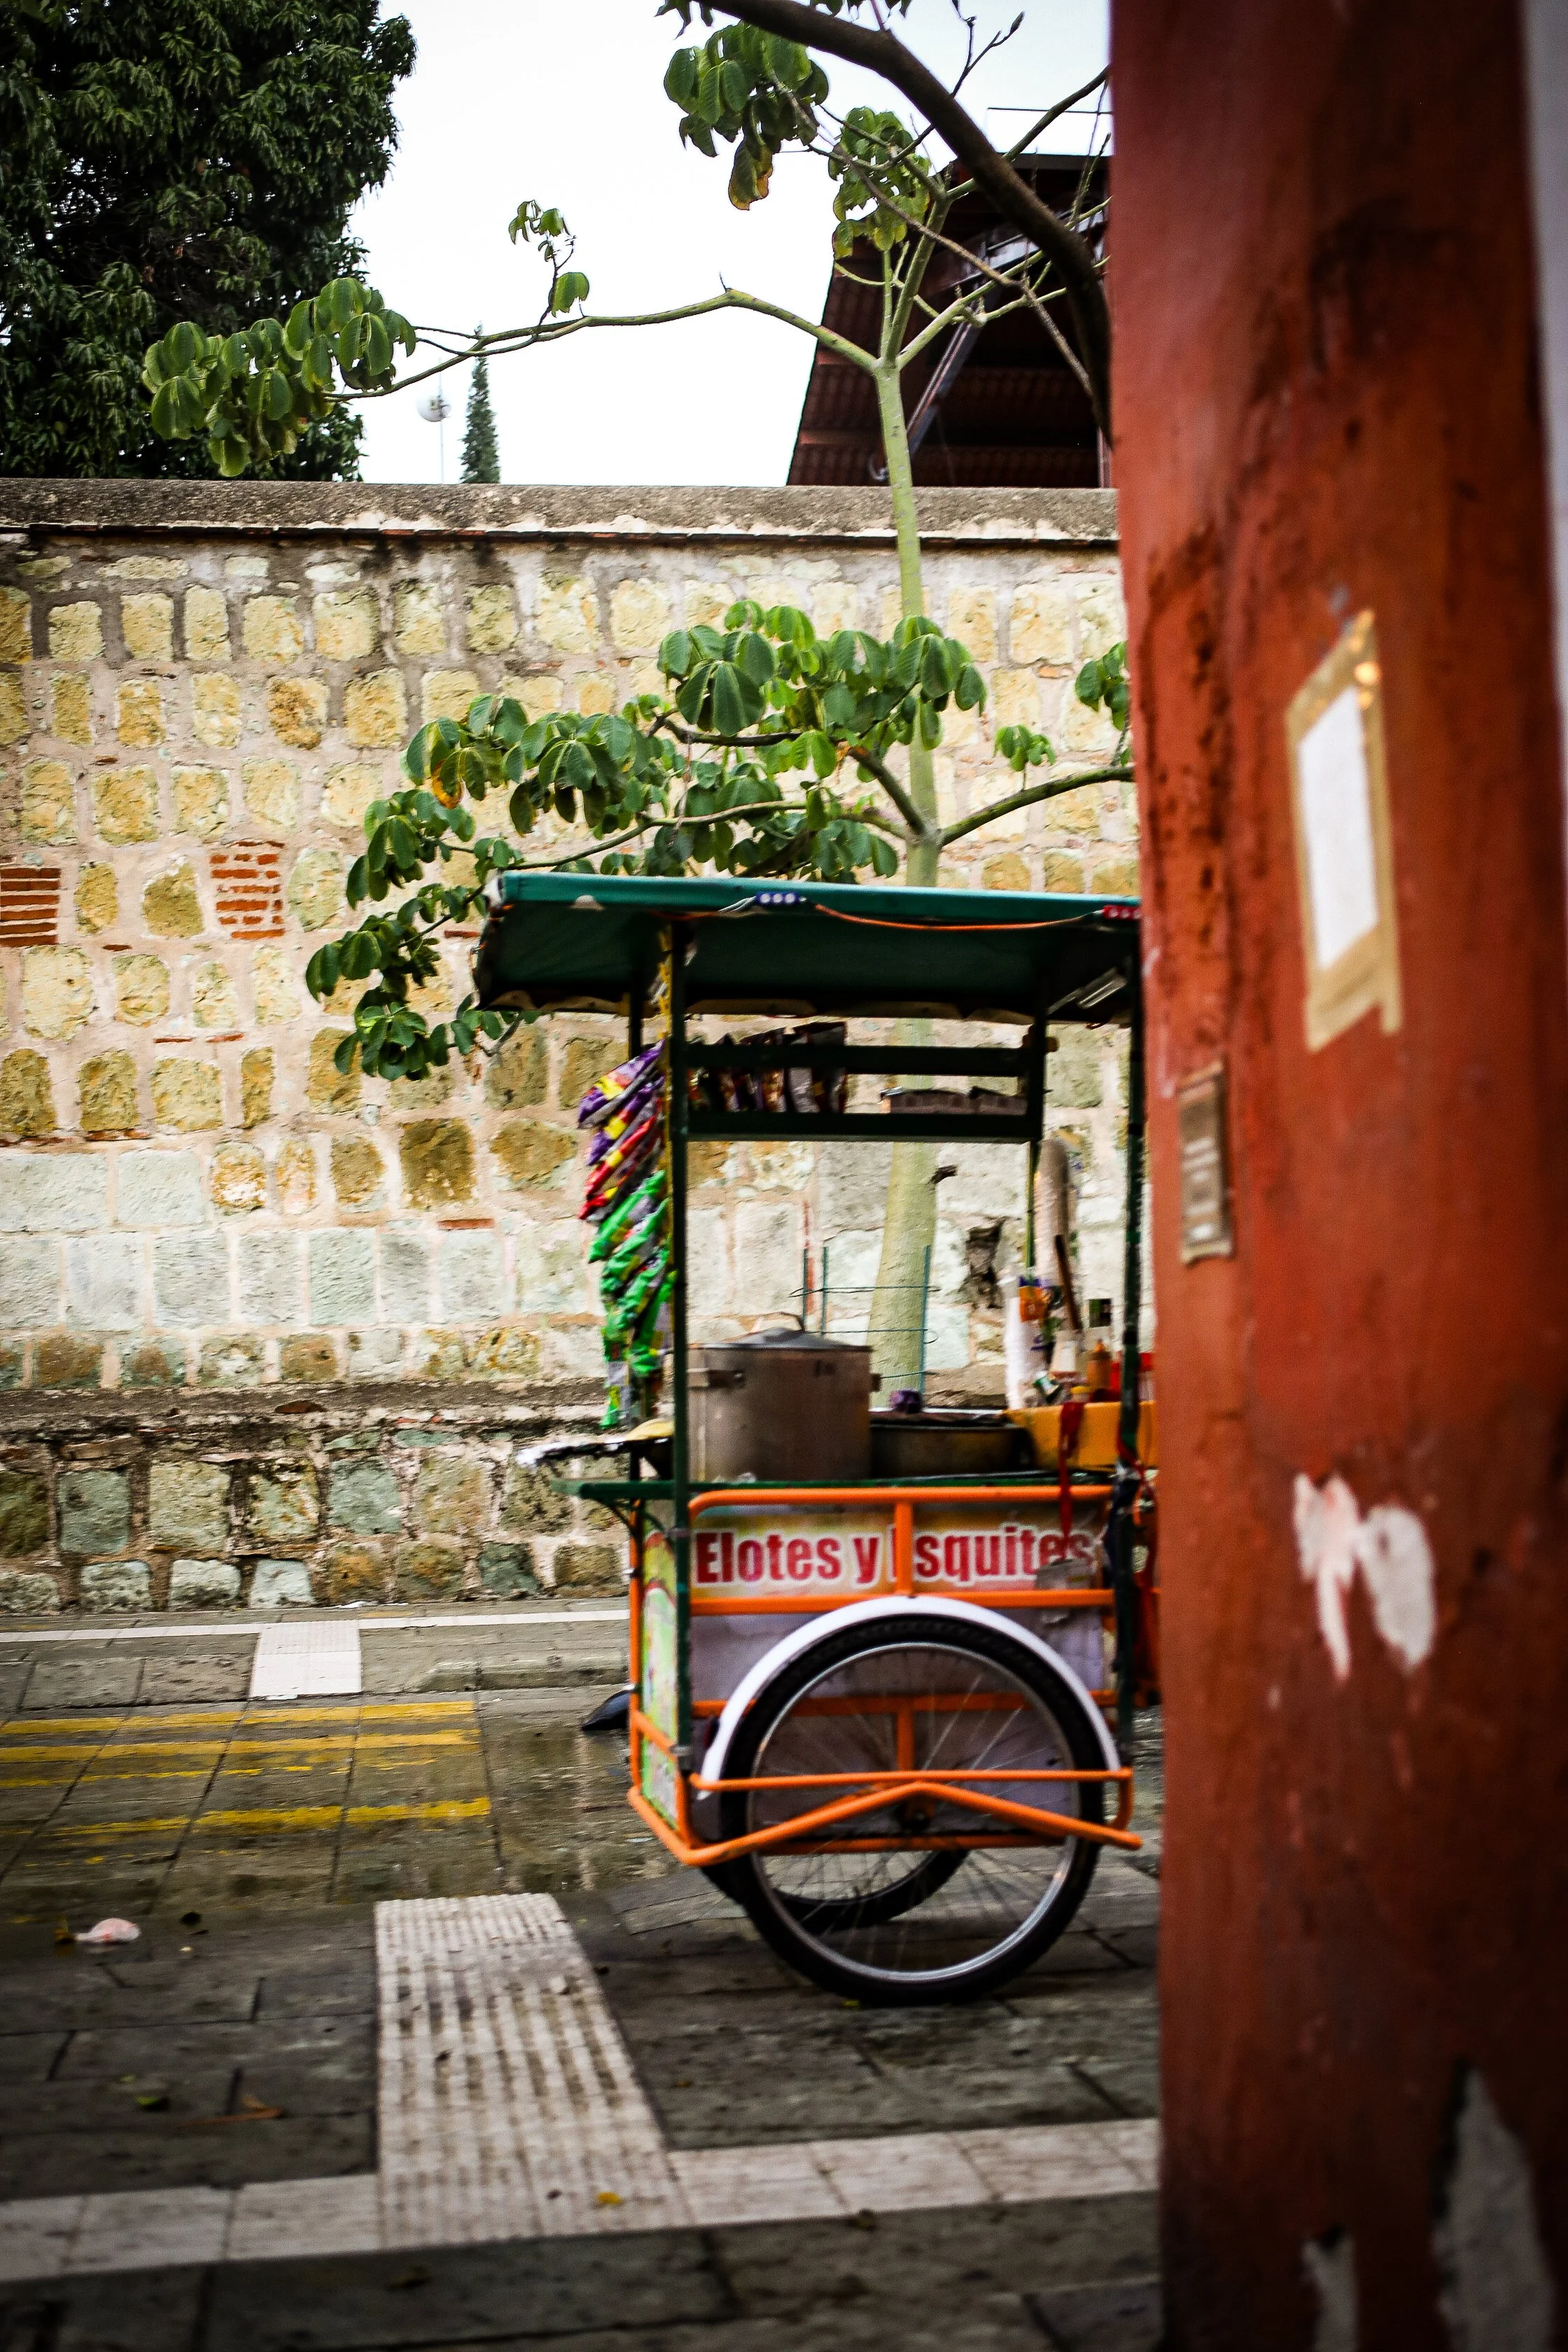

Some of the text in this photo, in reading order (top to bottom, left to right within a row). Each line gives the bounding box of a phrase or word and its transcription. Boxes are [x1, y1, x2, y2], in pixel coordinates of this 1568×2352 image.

[695, 1525, 1093, 1585] Elotes y squites
